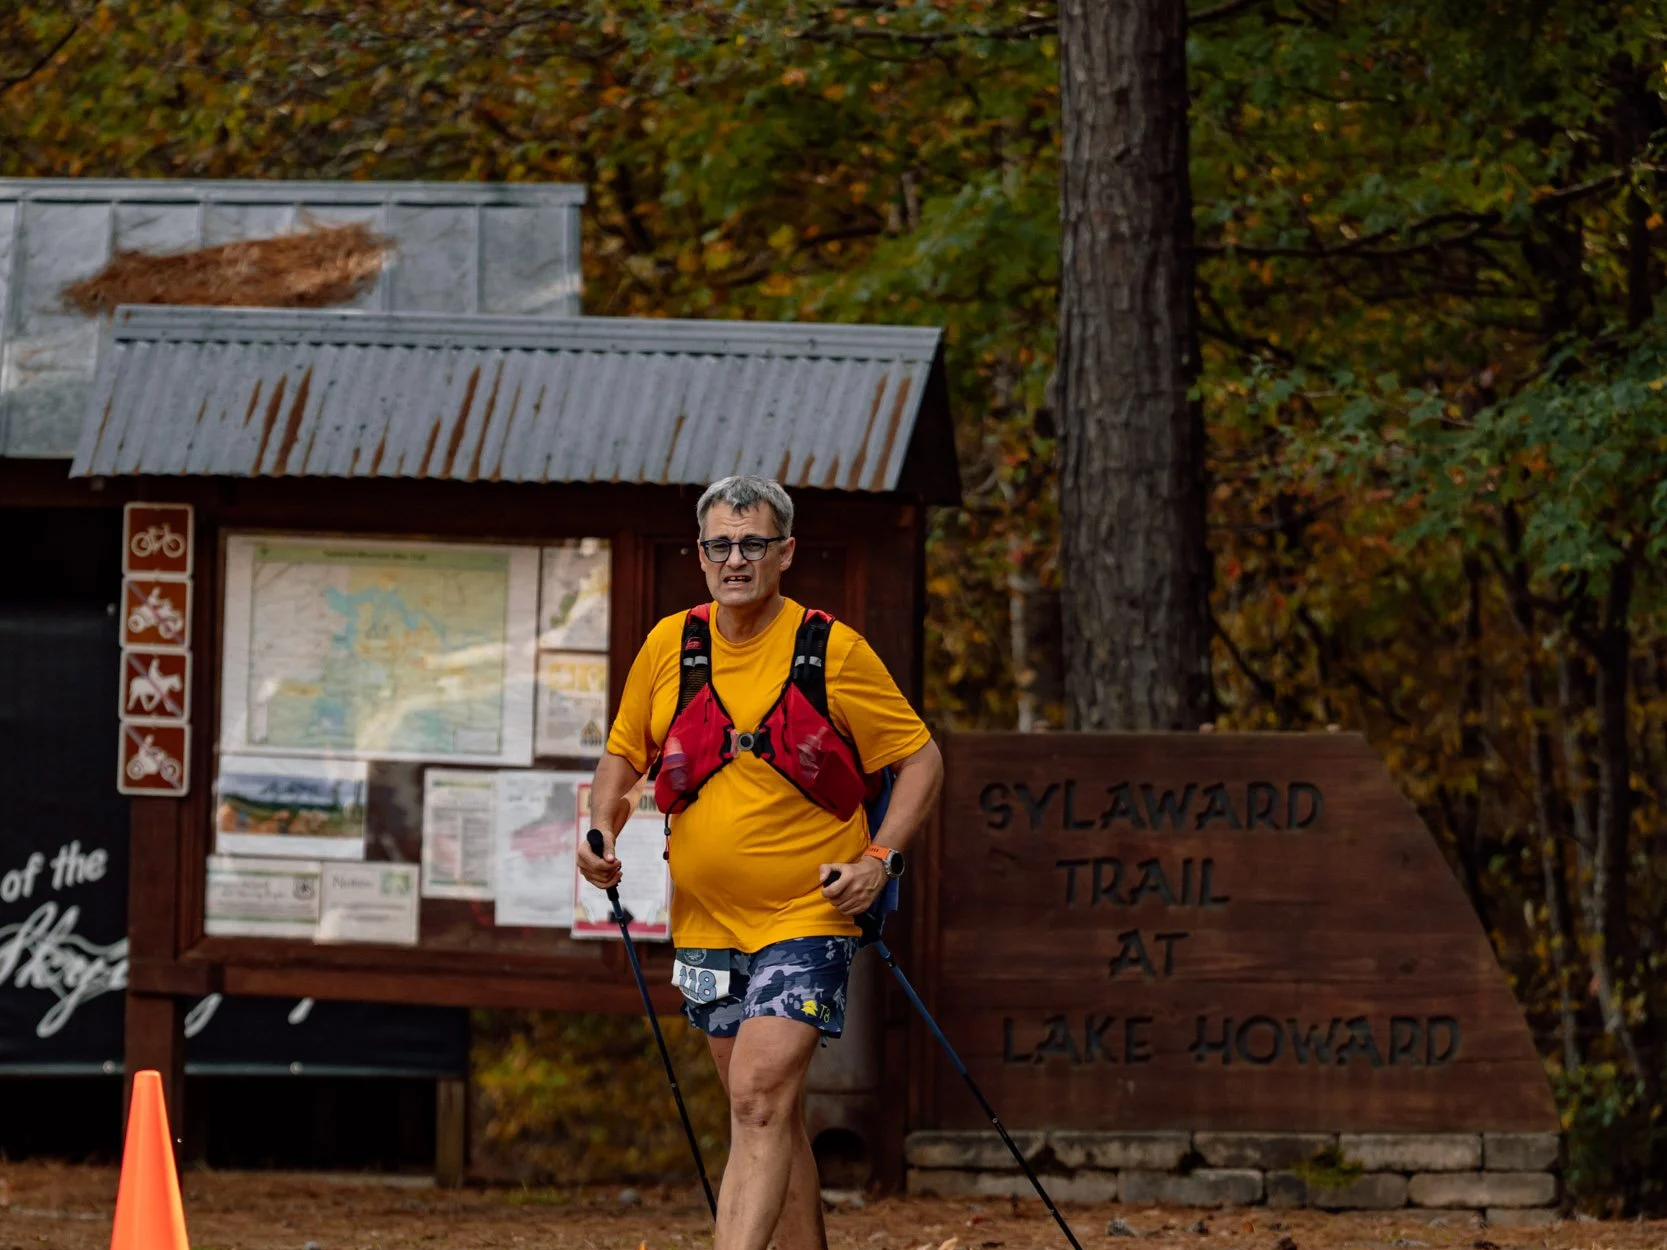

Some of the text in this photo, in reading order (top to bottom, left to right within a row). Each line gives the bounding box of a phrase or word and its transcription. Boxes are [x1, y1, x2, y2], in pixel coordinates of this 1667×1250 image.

[979, 779, 1325, 832] SYLAWARD
[0, 840, 109, 902] of the
[1055, 857, 1232, 908] TRAIL
[1109, 928, 1189, 979] AT
[679, 965, 717, 1002] 118
[1001, 1015, 1463, 1067] LAKE HOWARD
